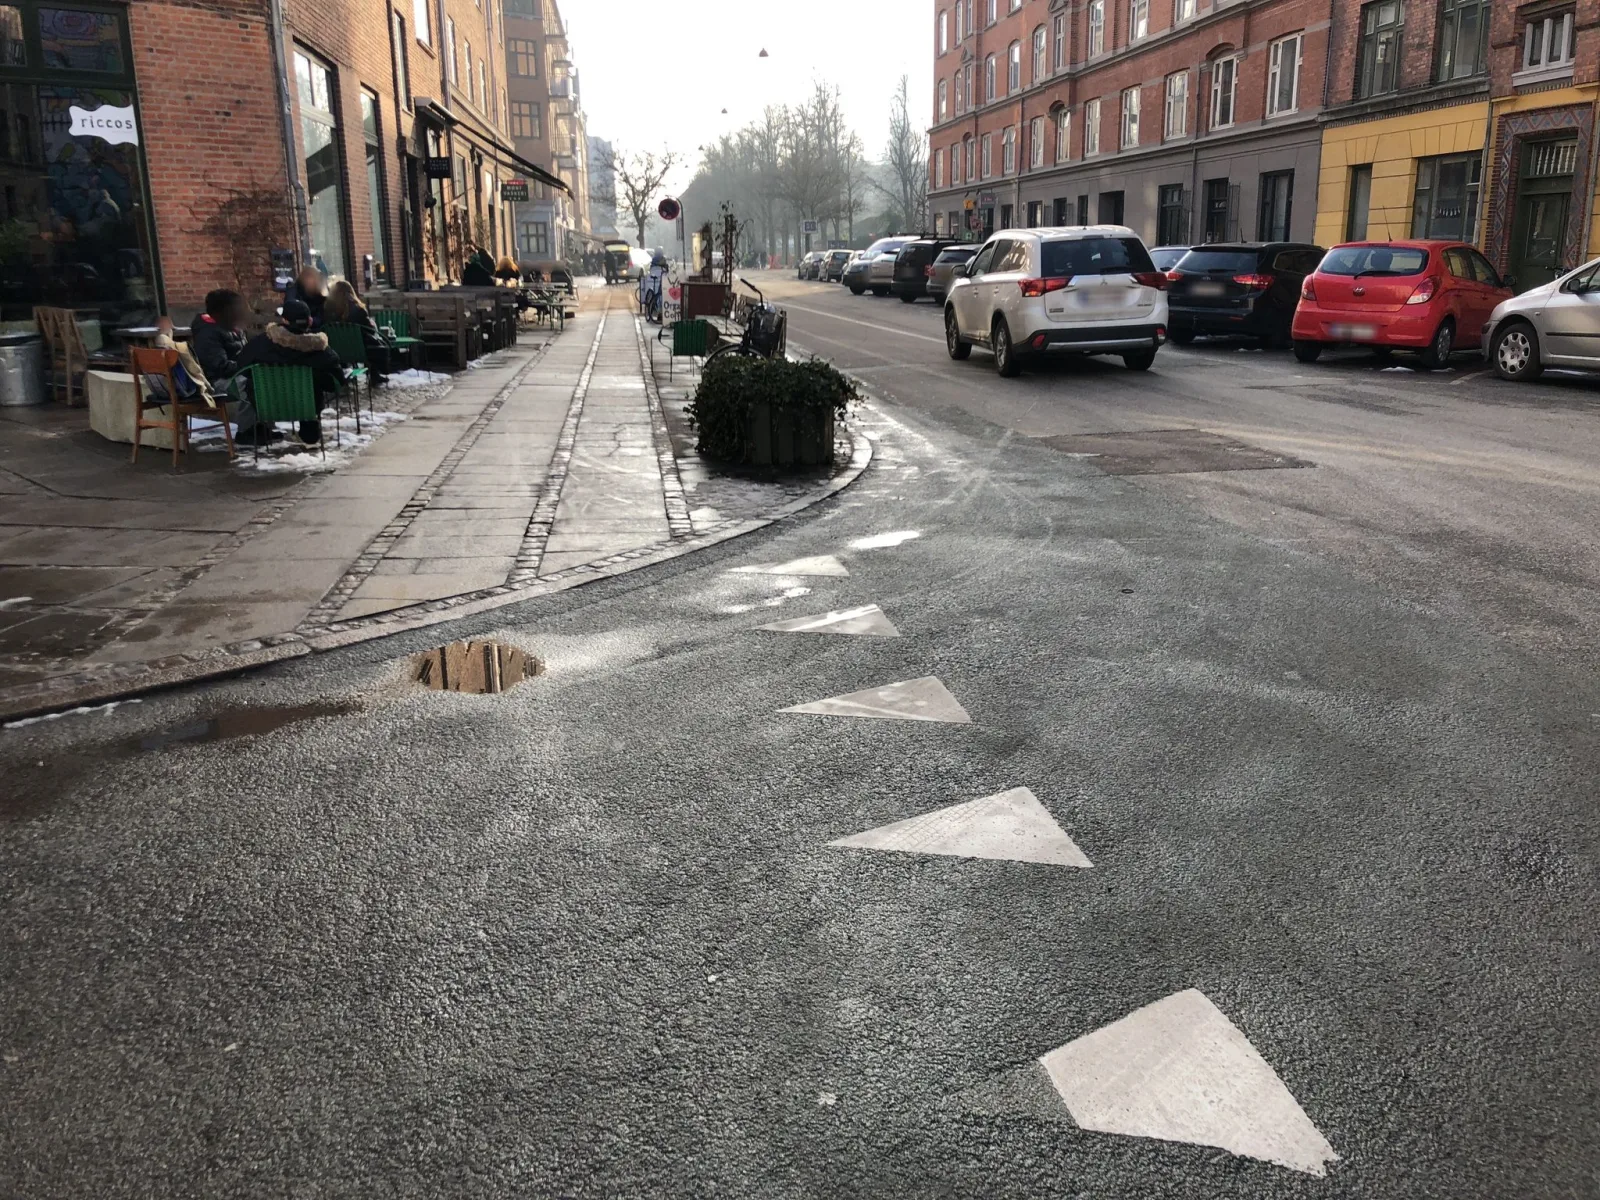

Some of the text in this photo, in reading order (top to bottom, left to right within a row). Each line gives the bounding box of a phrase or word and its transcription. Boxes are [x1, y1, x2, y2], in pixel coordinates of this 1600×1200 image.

[81, 115, 133, 129] riccos
[663, 301, 681, 311] Orga
[664, 311, 682, 322] Coff
